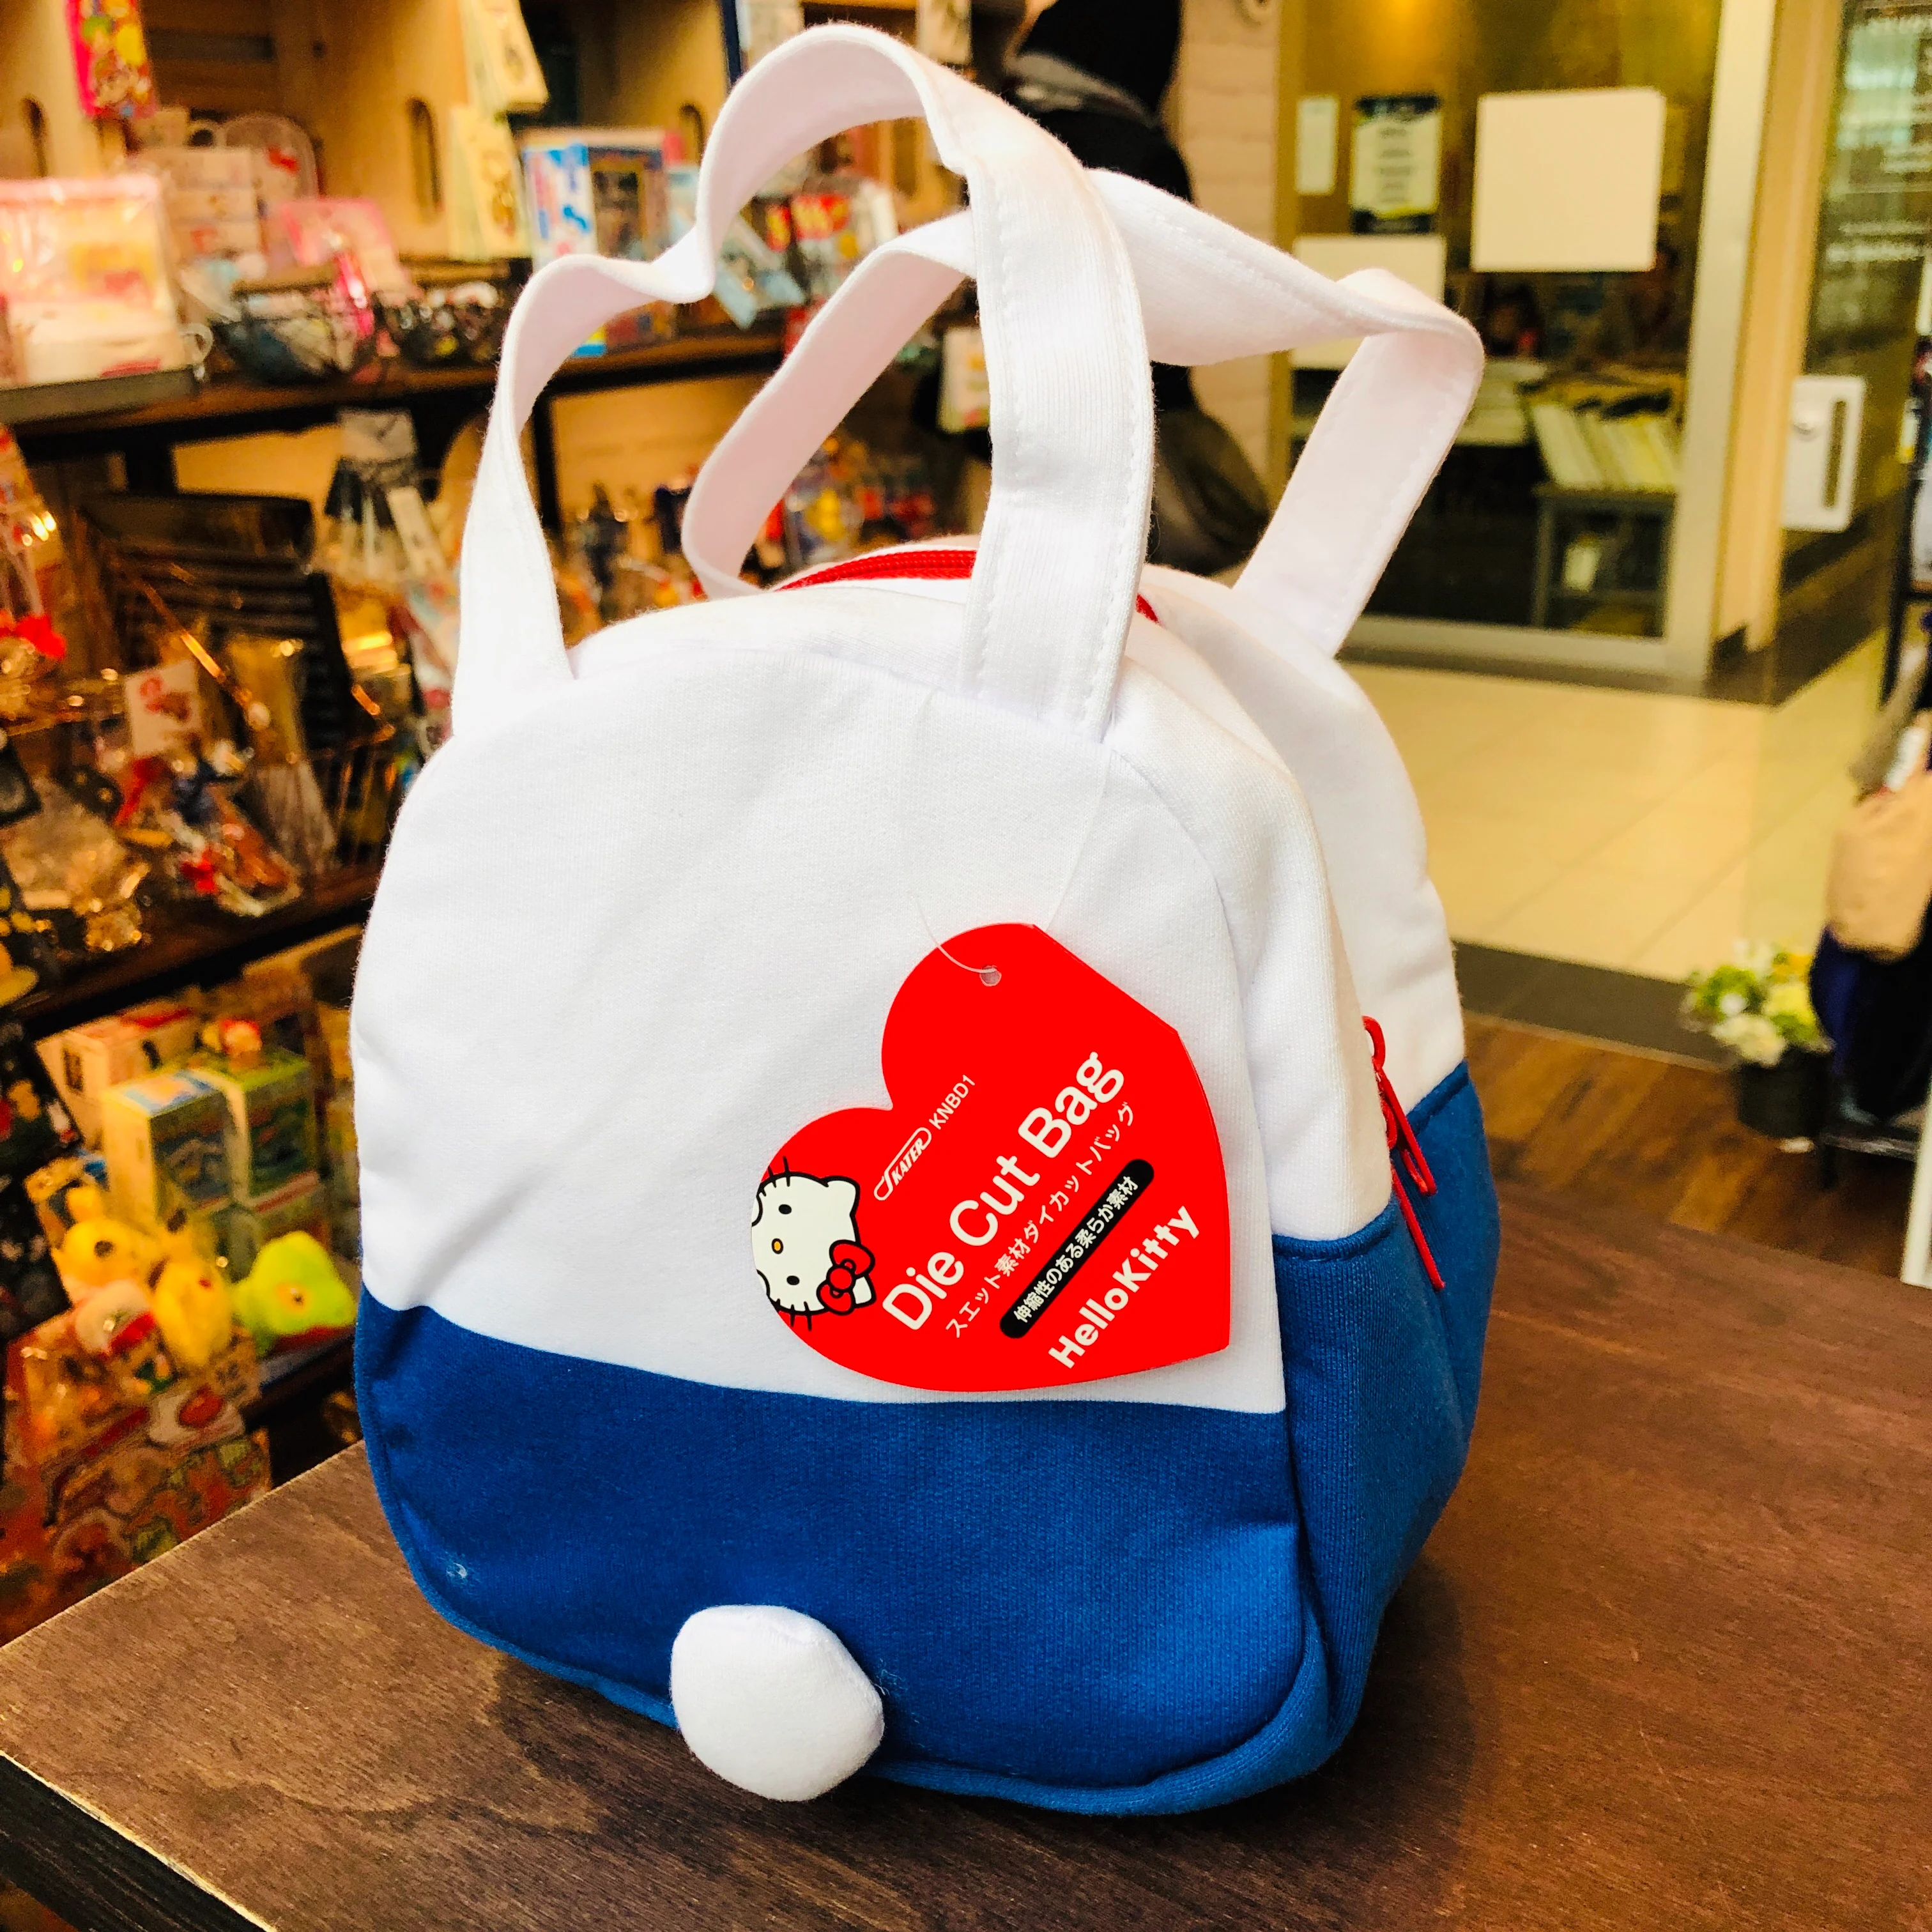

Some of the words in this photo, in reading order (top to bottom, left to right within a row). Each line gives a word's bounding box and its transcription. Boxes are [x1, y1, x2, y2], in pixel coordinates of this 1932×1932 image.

[874, 1128, 931, 1200] SKATER
[929, 1075, 975, 1130] KNBD1
[883, 1252, 963, 1330] Die
[950, 1156, 1040, 1246] Cut
[1018, 1052, 1124, 1158] Bag
[946, 1102, 1133, 1338] スエット素材ダイカットバッグ
[1014, 1176, 1138, 1323] 伸縮性のある柔らか素材
